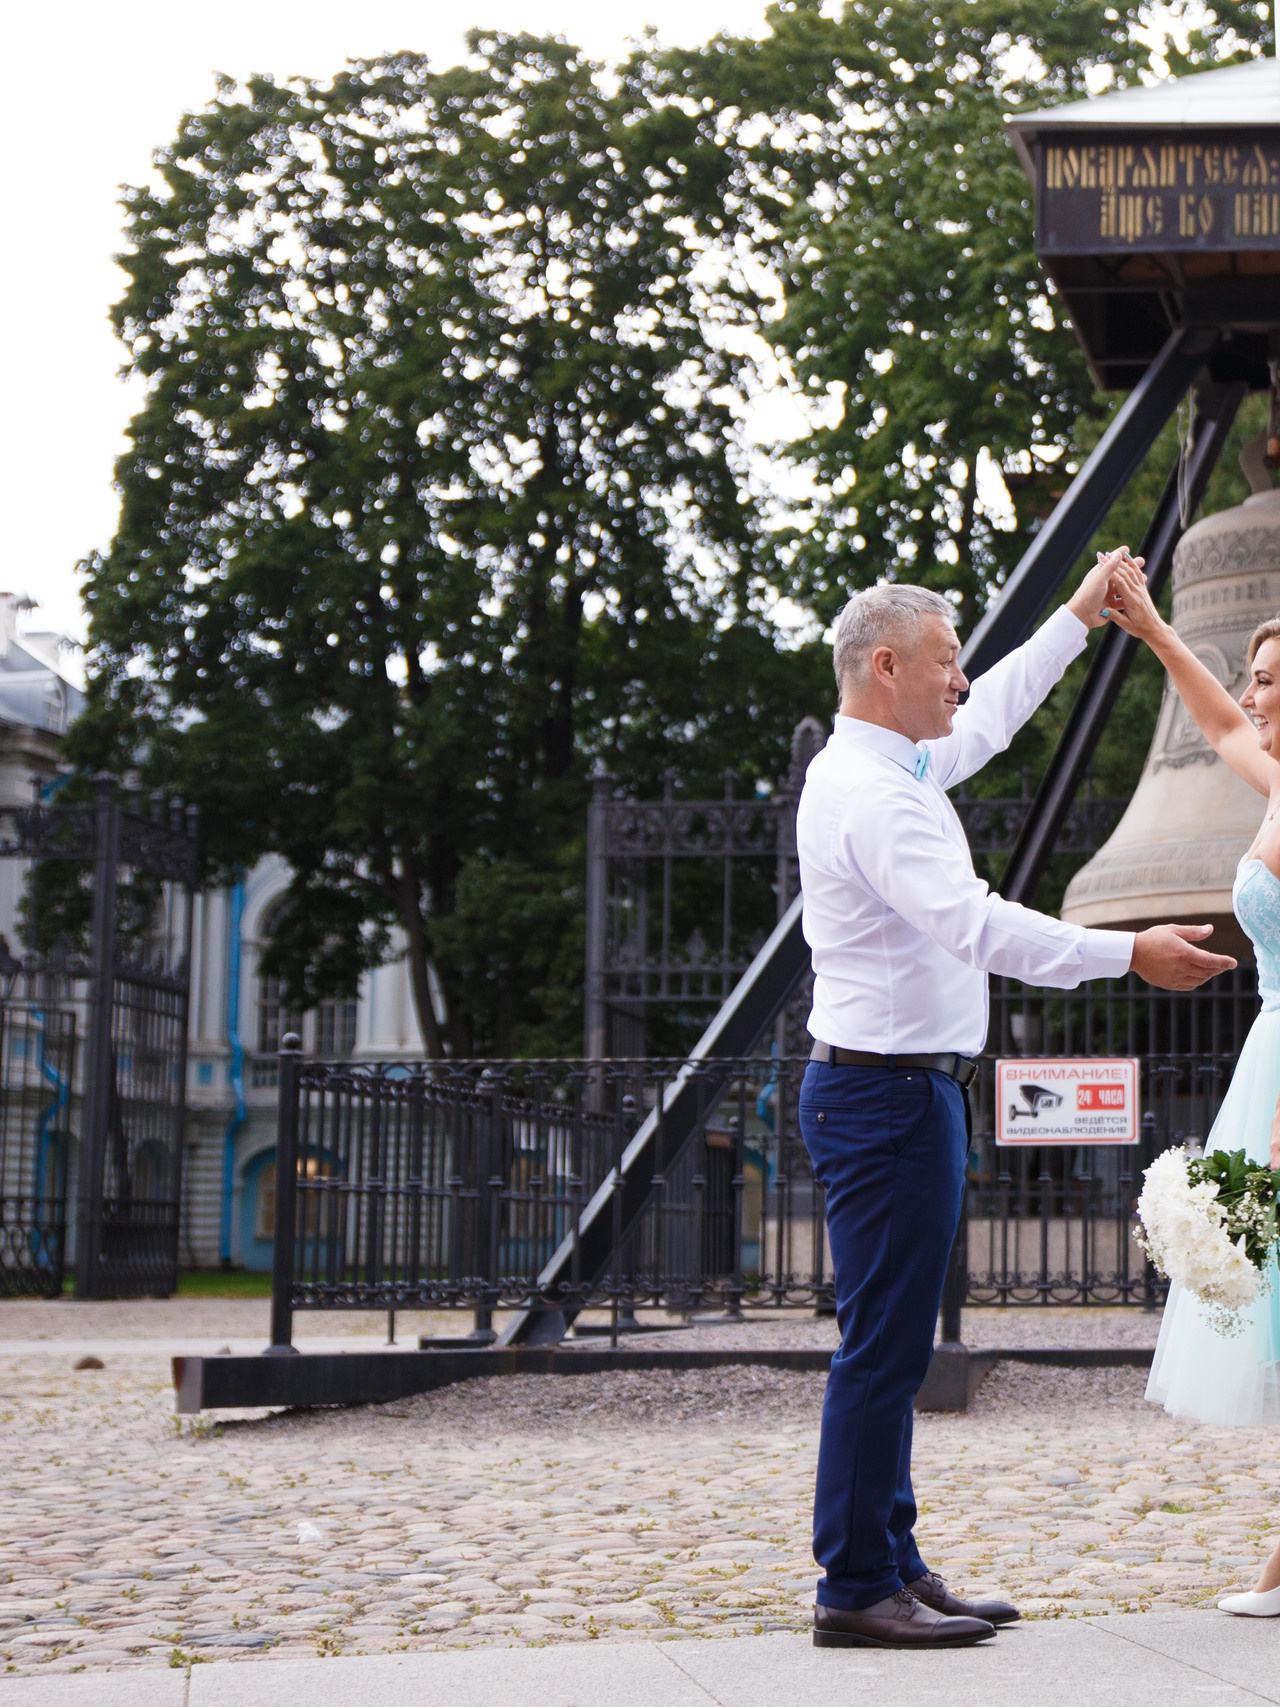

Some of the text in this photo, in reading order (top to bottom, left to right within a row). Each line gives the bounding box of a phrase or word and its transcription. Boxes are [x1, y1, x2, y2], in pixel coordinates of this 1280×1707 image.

[1005, 1068, 1128, 1081] ВНИМАНИЕ!
[1078, 1089, 1124, 1105] 24 ЧАСА
[1006, 1126, 1128, 1136] ВИДЕОНАБЛЮДЕНИЕ
